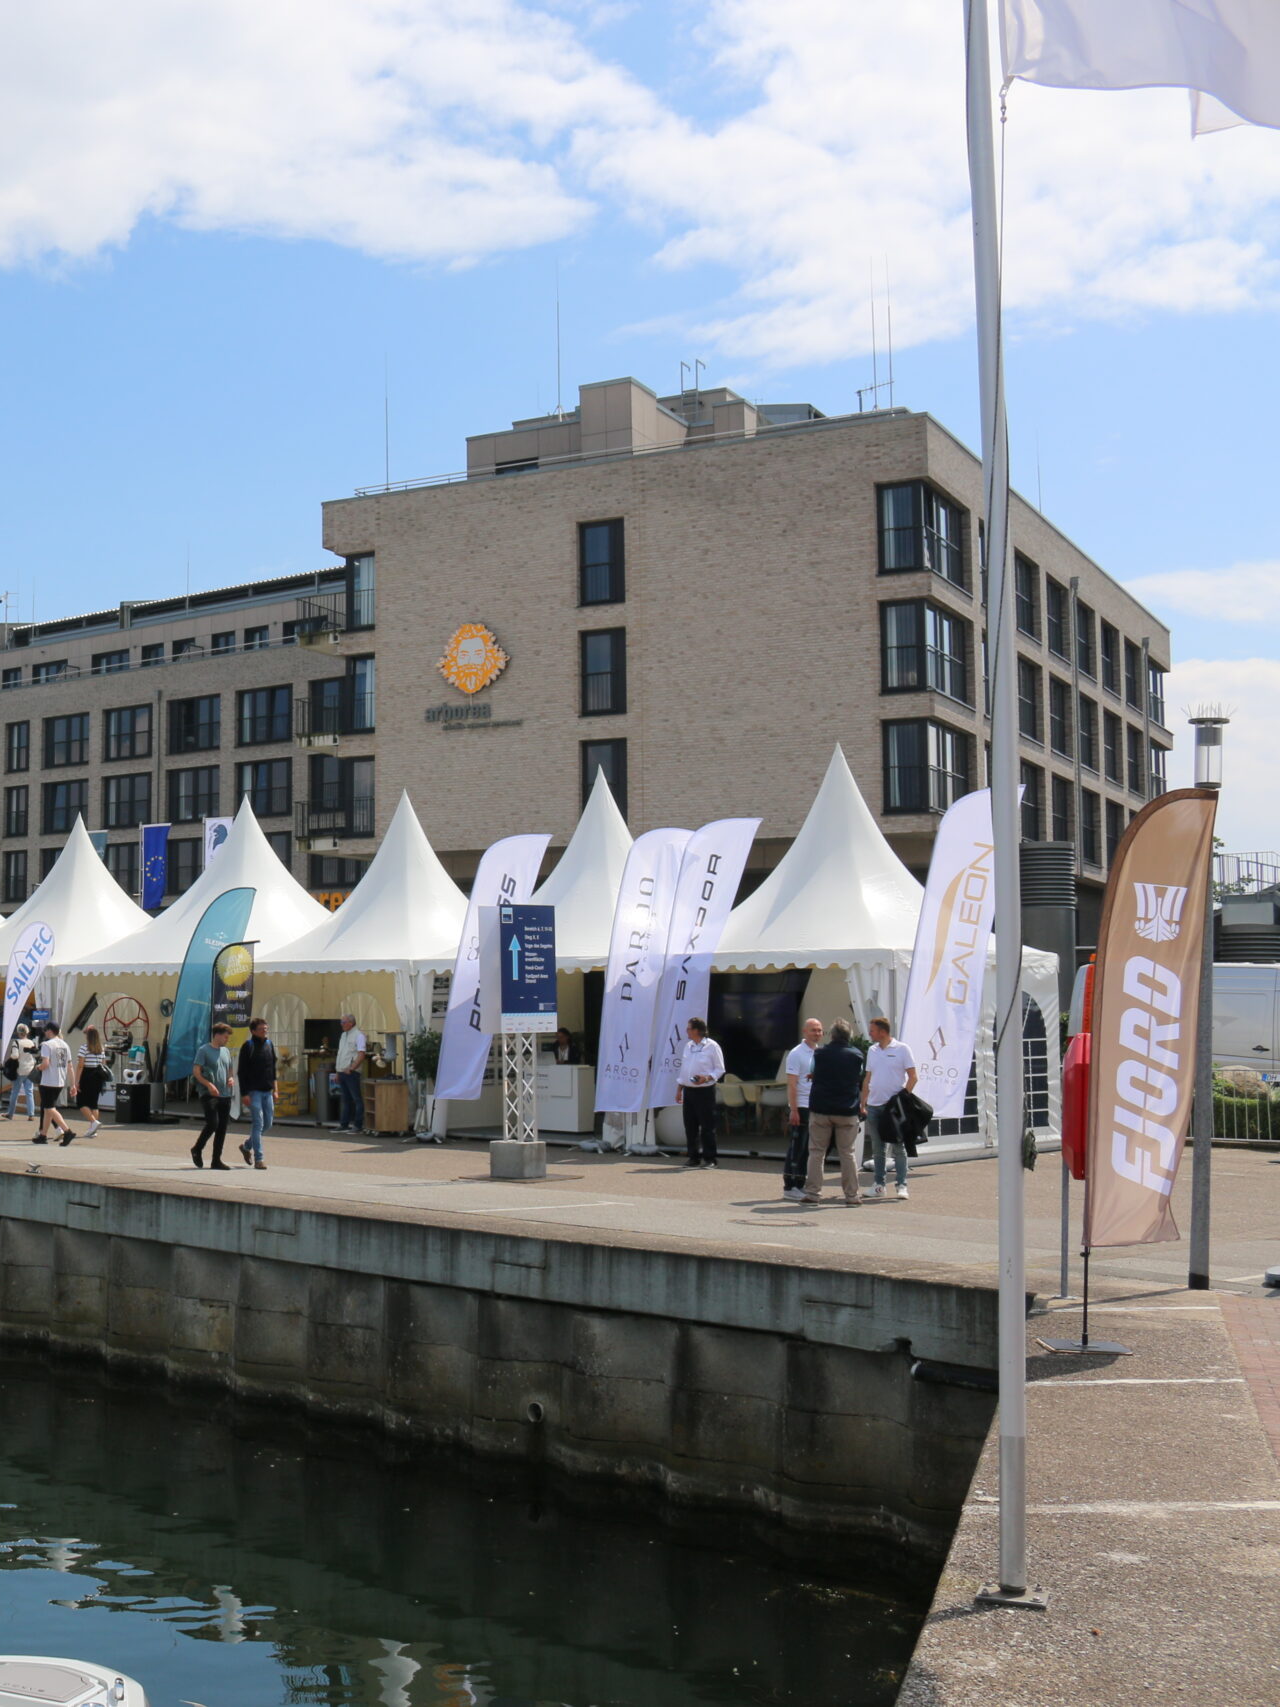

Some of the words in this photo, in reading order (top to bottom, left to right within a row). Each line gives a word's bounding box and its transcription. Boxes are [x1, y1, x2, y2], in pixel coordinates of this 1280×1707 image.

[945, 841, 995, 1006] GALEON
[6, 926, 53, 1006] SAILTEC
[605, 1063, 639, 1078] ARGO
[920, 1063, 959, 1079] RGO
[1111, 955, 1182, 1196] FJORD
